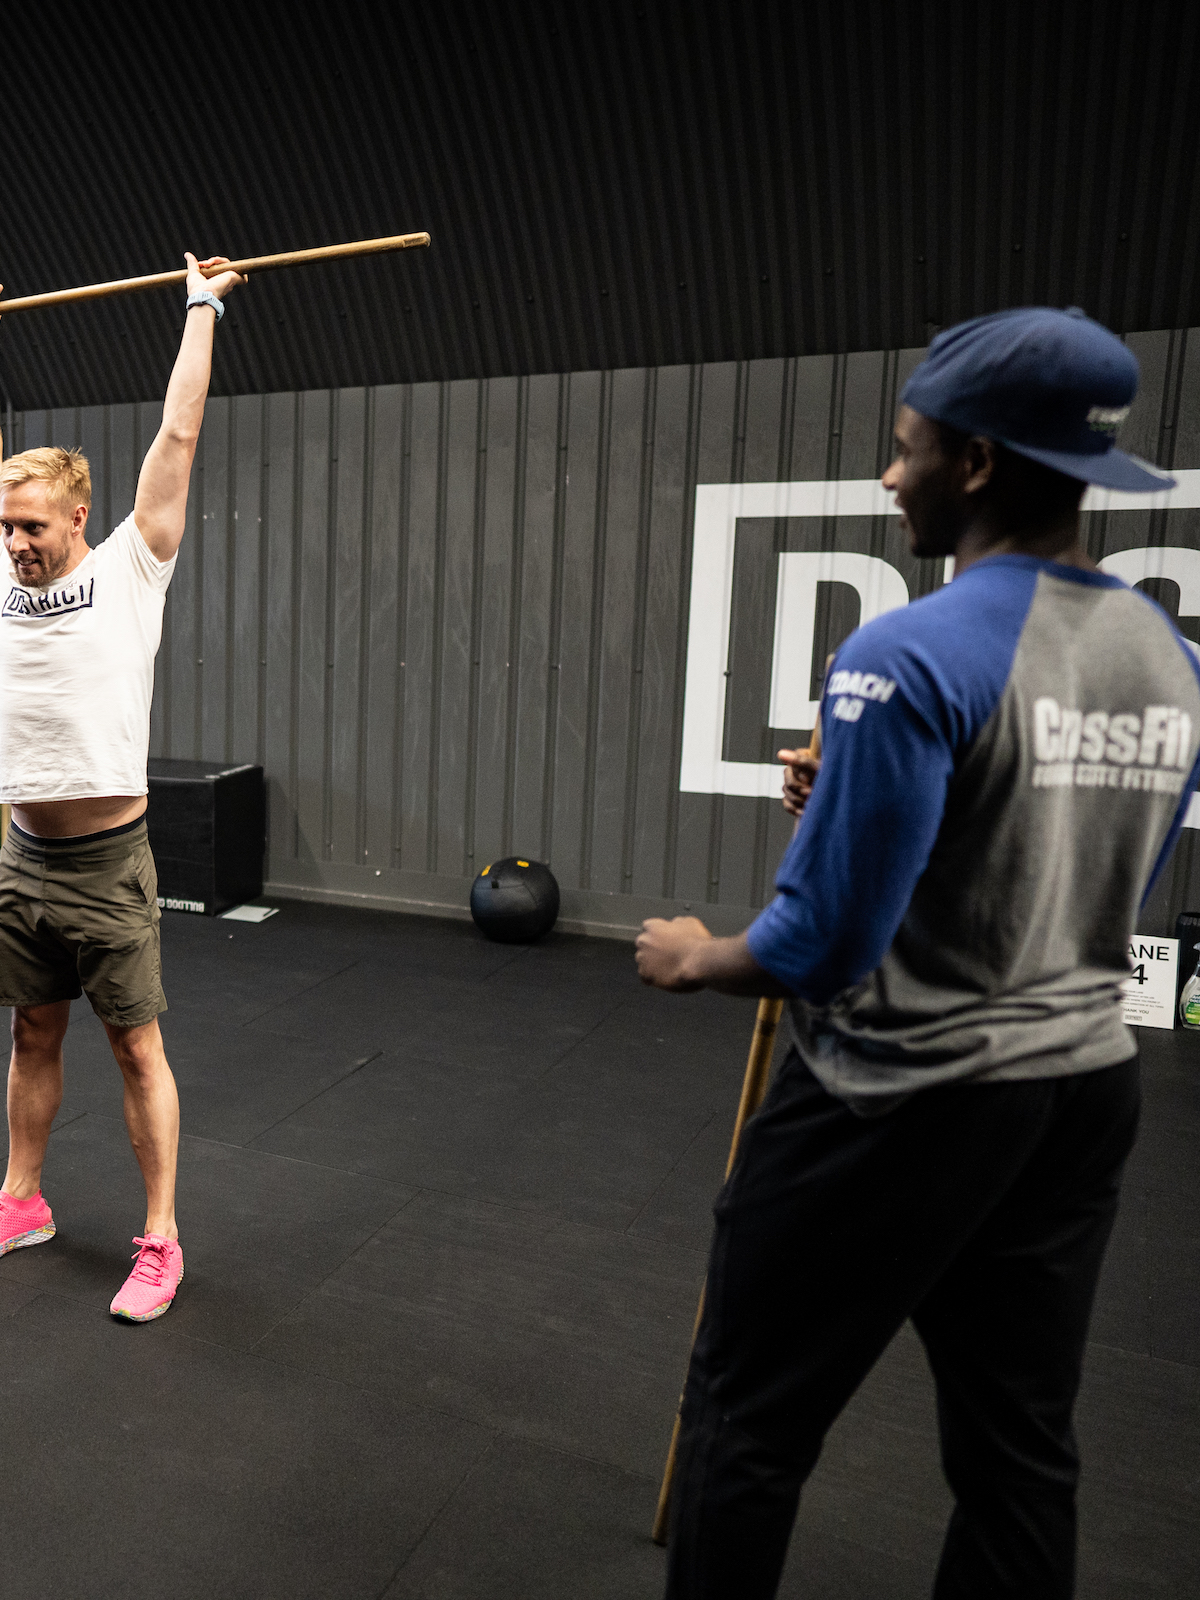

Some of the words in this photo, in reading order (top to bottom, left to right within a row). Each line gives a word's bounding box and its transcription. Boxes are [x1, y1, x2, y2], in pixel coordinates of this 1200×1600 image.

[166, 898, 205, 913] BULLDOG
[1128, 943, 1170, 962] ANE
[1131, 963, 1148, 985] 4
